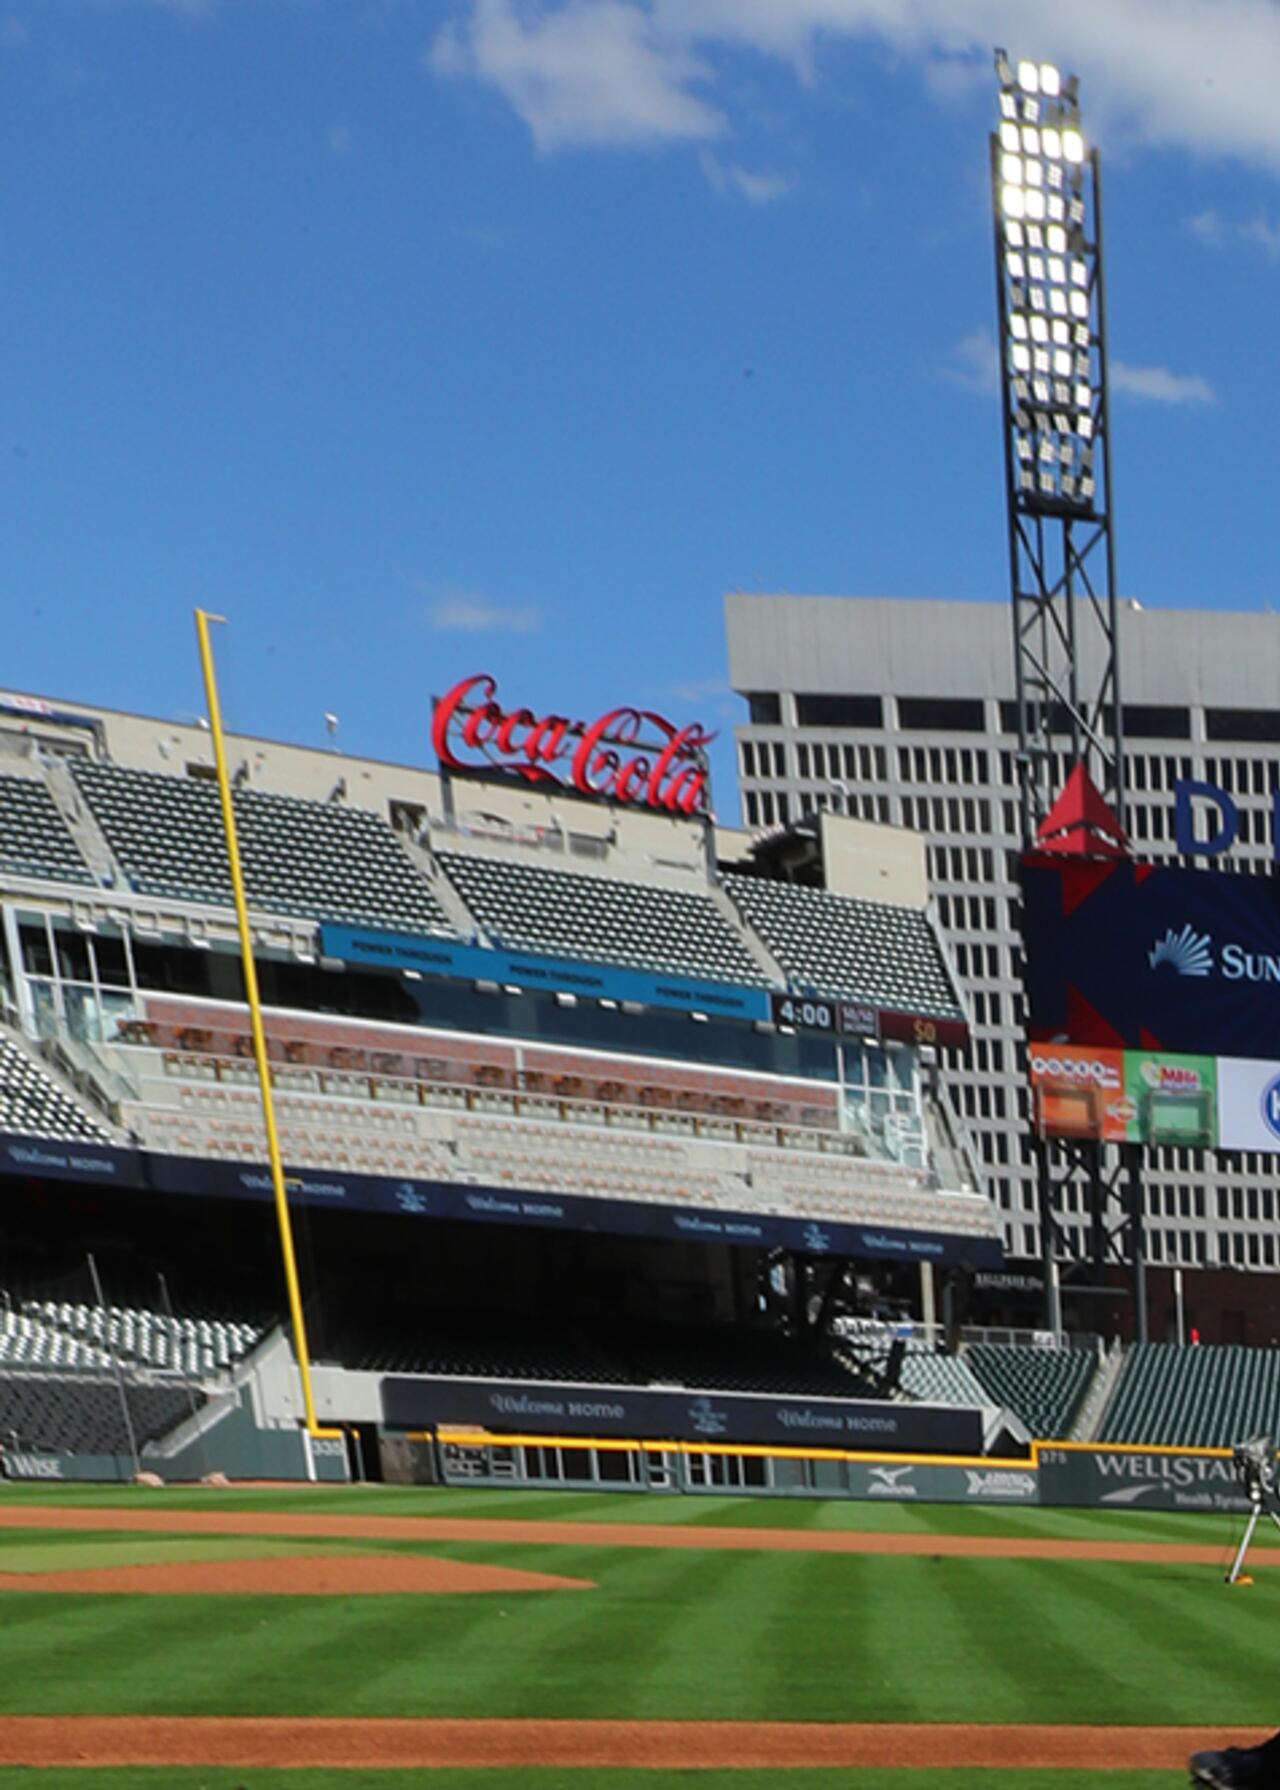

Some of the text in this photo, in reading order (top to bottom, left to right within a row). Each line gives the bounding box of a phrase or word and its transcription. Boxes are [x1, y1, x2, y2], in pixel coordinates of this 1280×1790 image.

[780, 1002, 831, 1027] 4:00
[913, 1019, 936, 1042] $0
[490, 1394, 564, 1416] Welcome
[777, 1408, 844, 1430] Welcome
